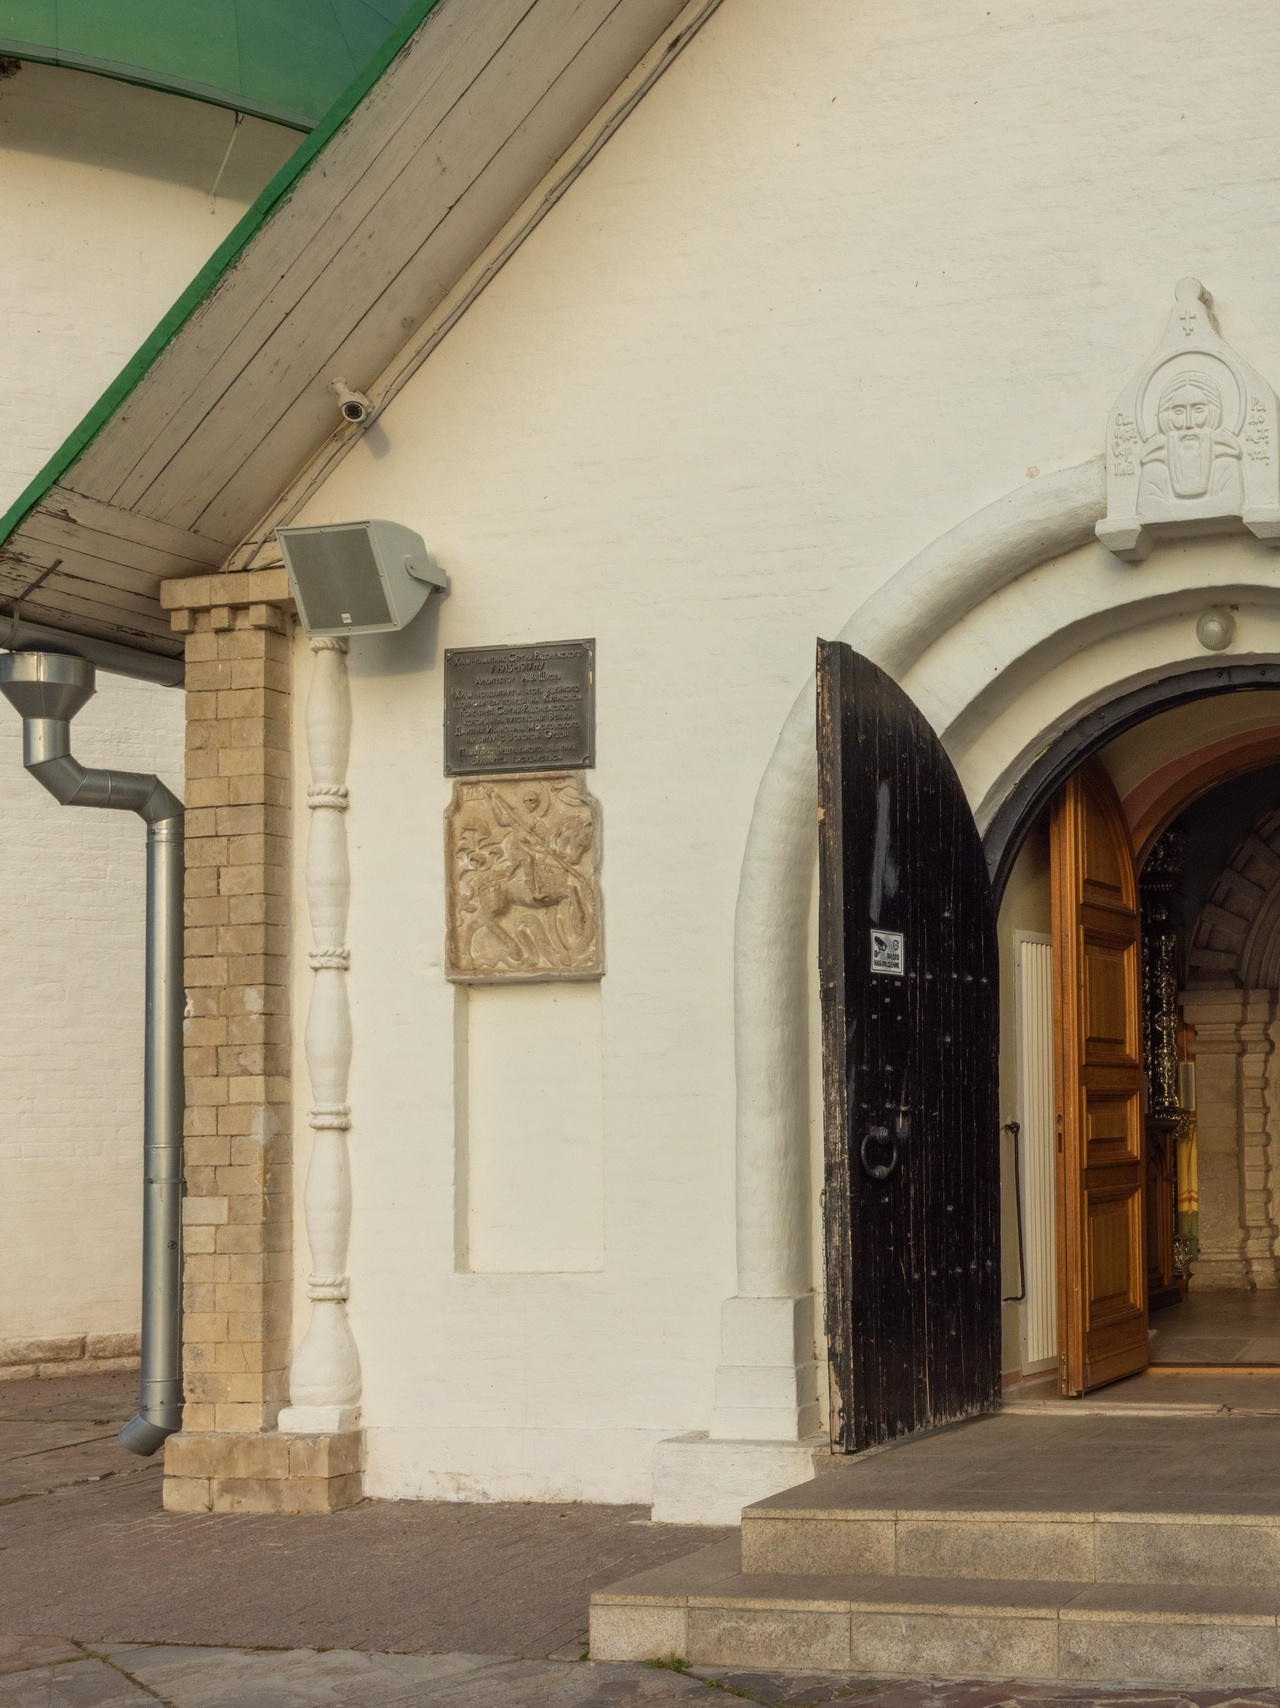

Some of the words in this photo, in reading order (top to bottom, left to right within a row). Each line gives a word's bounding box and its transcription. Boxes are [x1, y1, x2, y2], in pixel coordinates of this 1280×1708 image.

[535, 650, 583, 662] Радонежского
[475, 676, 516, 686] Архитектор
[539, 671, 562, 682] Щусев
[455, 690, 473, 700] Храм
[874, 960, 899, 969] НАБЛЮДЕНИЕ
